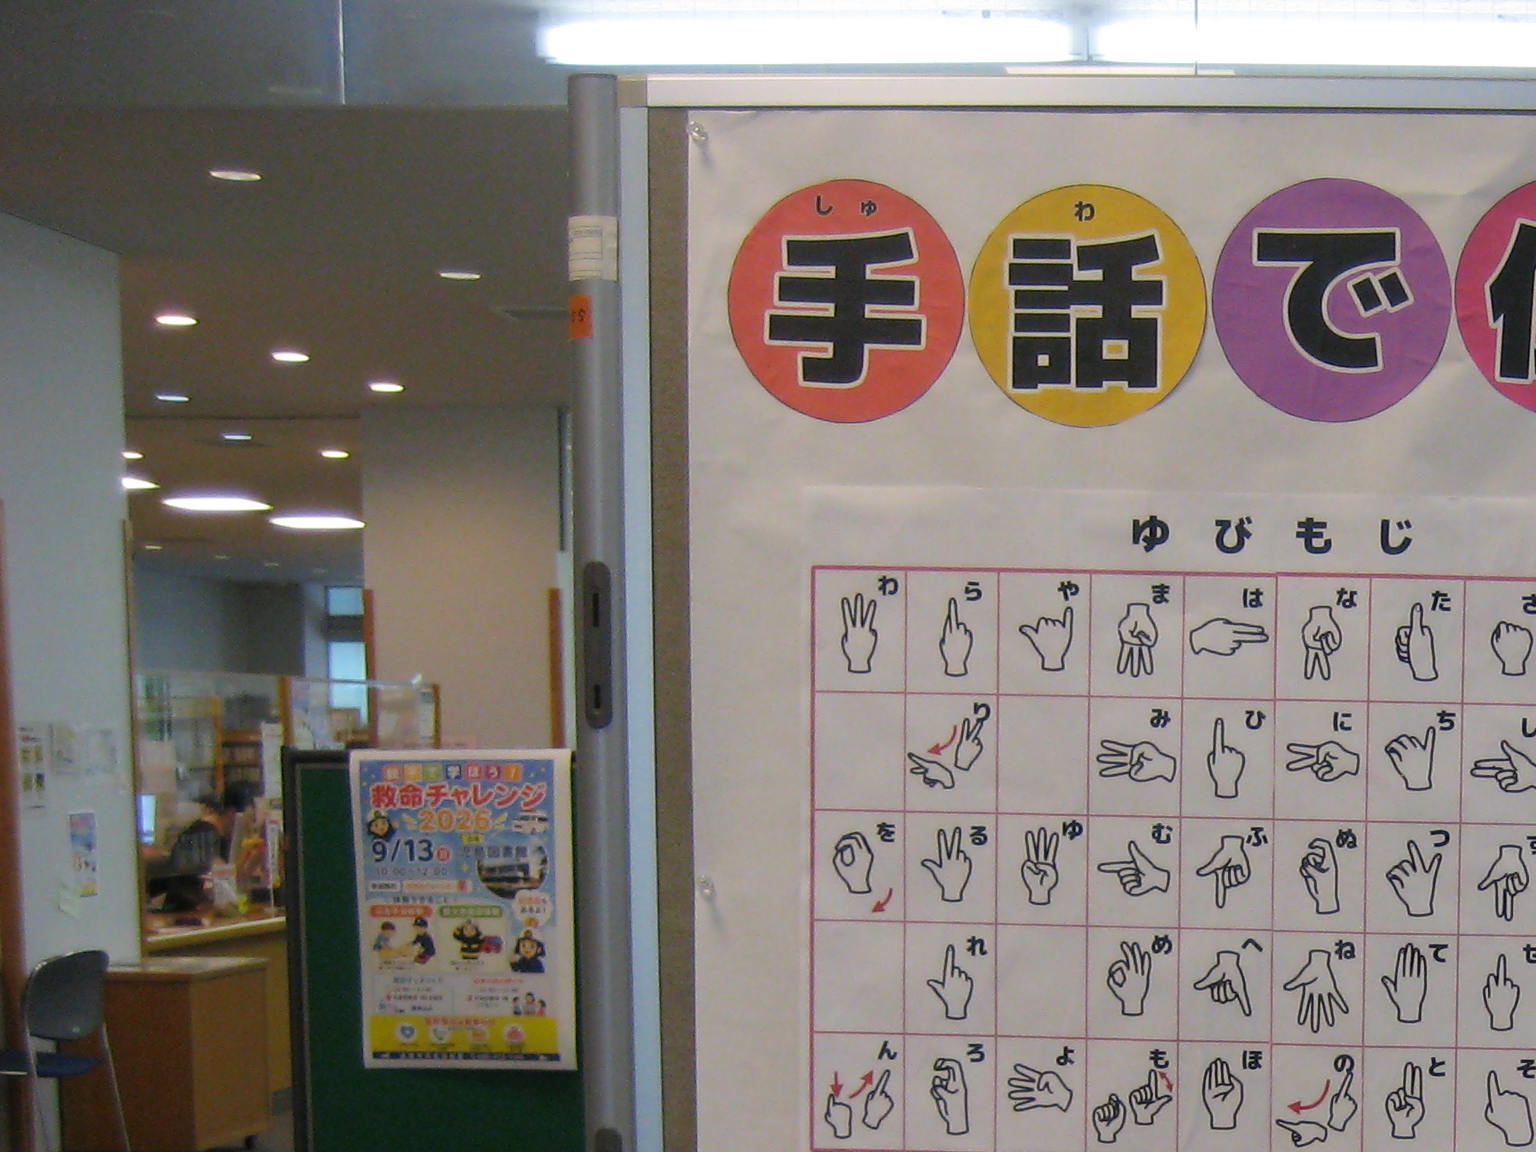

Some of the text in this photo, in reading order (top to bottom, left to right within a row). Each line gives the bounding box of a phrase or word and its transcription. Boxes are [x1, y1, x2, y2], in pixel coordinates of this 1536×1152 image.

[1074, 201, 1096, 222] わ
[1131, 515, 1415, 556] ゆびもじ
[877, 577, 898, 596] わ
[965, 582, 982, 601] ら
[1057, 581, 1080, 601] や
[1152, 584, 1170, 603] ま
[1243, 589, 1263, 608] は
[1336, 588, 1357, 607] な
[1431, 591, 1451, 611] た
[973, 703, 990, 722] り
[1150, 709, 1171, 727] み
[1245, 711, 1265, 729] ひ
[1333, 712, 1352, 731] に
[1437, 712, 1455, 731] ち
[371, 783, 547, 810] 救命チャレンジ
[418, 810, 493, 832] 2026
[1062, 821, 1083, 840] ゆ
[877, 823, 896, 842] を
[971, 826, 988, 845] る
[1152, 824, 1171, 843] む
[1246, 827, 1268, 846] ふ
[1336, 829, 1357, 849] ぬ
[1430, 830, 1450, 847] つ
[371, 838, 434, 864] 9/13
[967, 937, 987, 955] れ
[1152, 936, 1172, 955] め
[1242, 937, 1263, 953] へ
[1335, 940, 1356, 959] ね
[1429, 944, 1448, 963] て
[877, 1041, 897, 1060] ん
[968, 1044, 985, 1062] ろ
[1056, 1046, 1074, 1065] よ
[1150, 1049, 1169, 1067] も
[1242, 1050, 1262, 1070] ほ
[1334, 1054, 1354, 1072] の
[1429, 1057, 1446, 1076] と
[1518, 1059, 1536, 1078] そ
